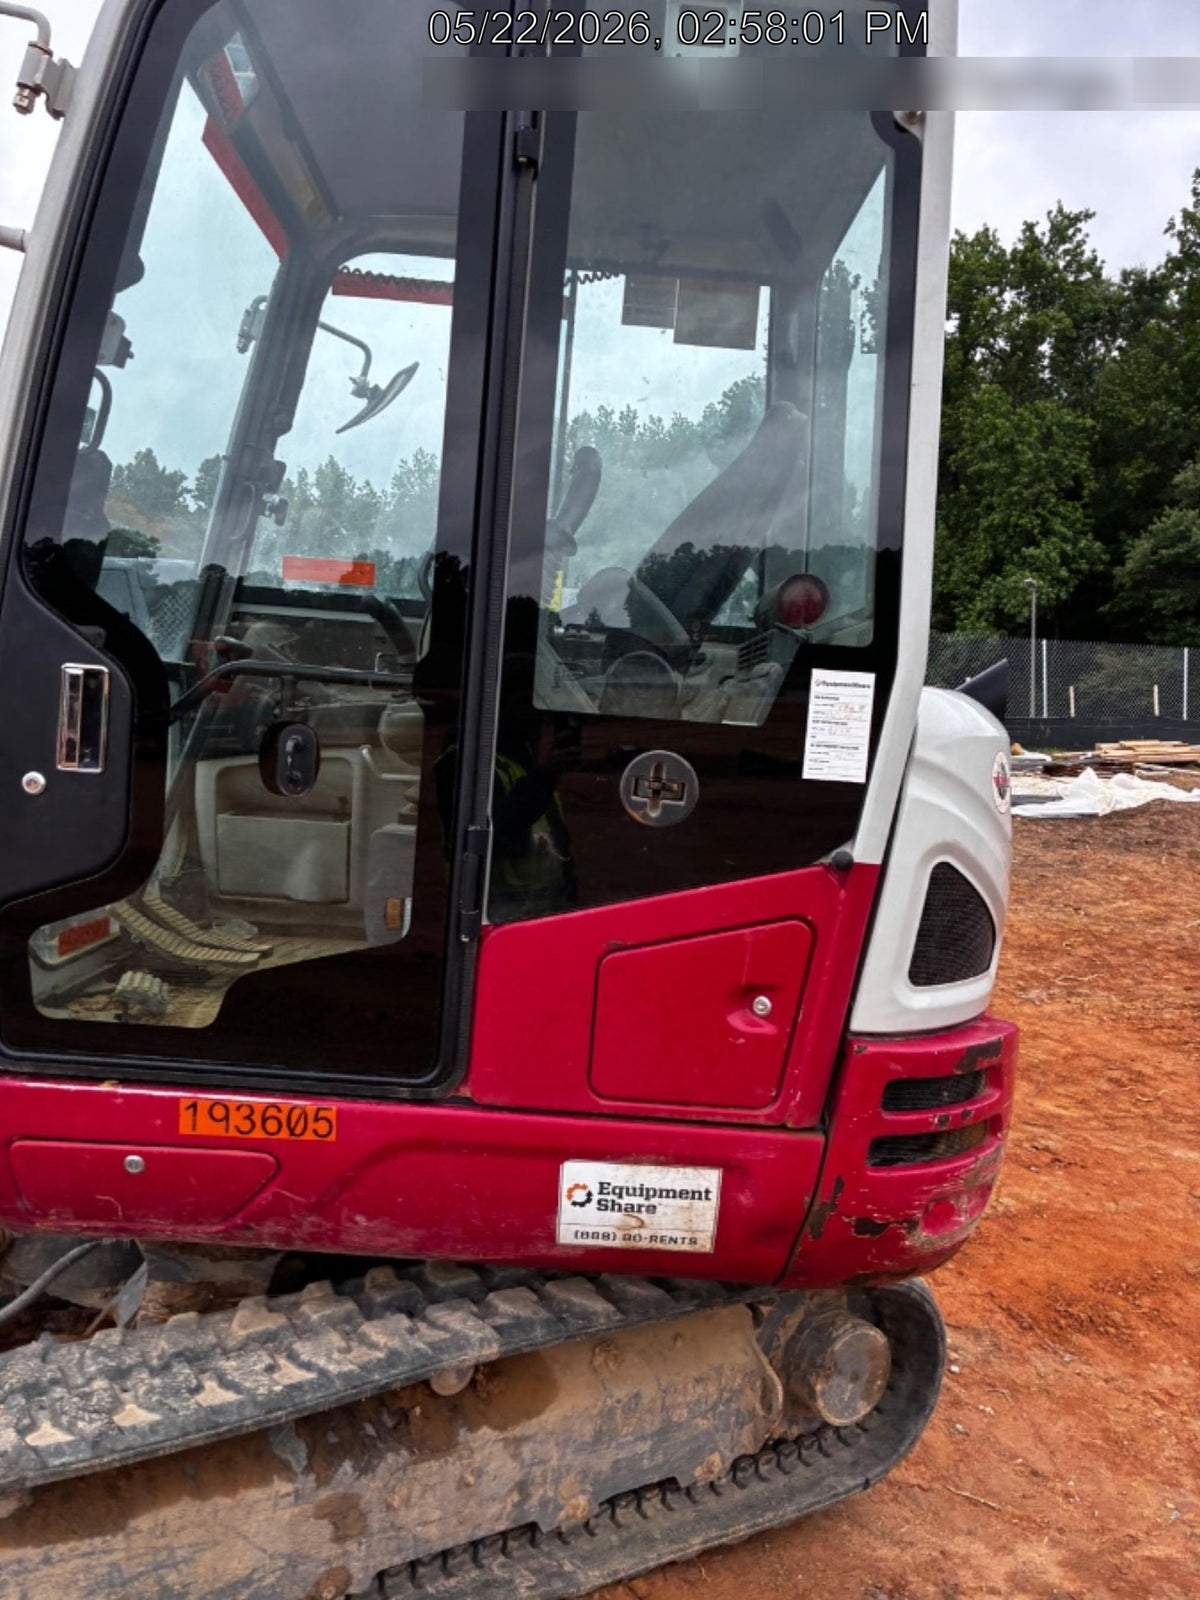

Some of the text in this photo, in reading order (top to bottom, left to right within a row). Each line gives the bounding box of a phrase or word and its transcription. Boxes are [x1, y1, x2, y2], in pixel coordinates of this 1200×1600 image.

[185, 1101, 334, 1138] 193605
[597, 1182, 712, 1201] Equipment
[597, 1198, 657, 1214] Share
